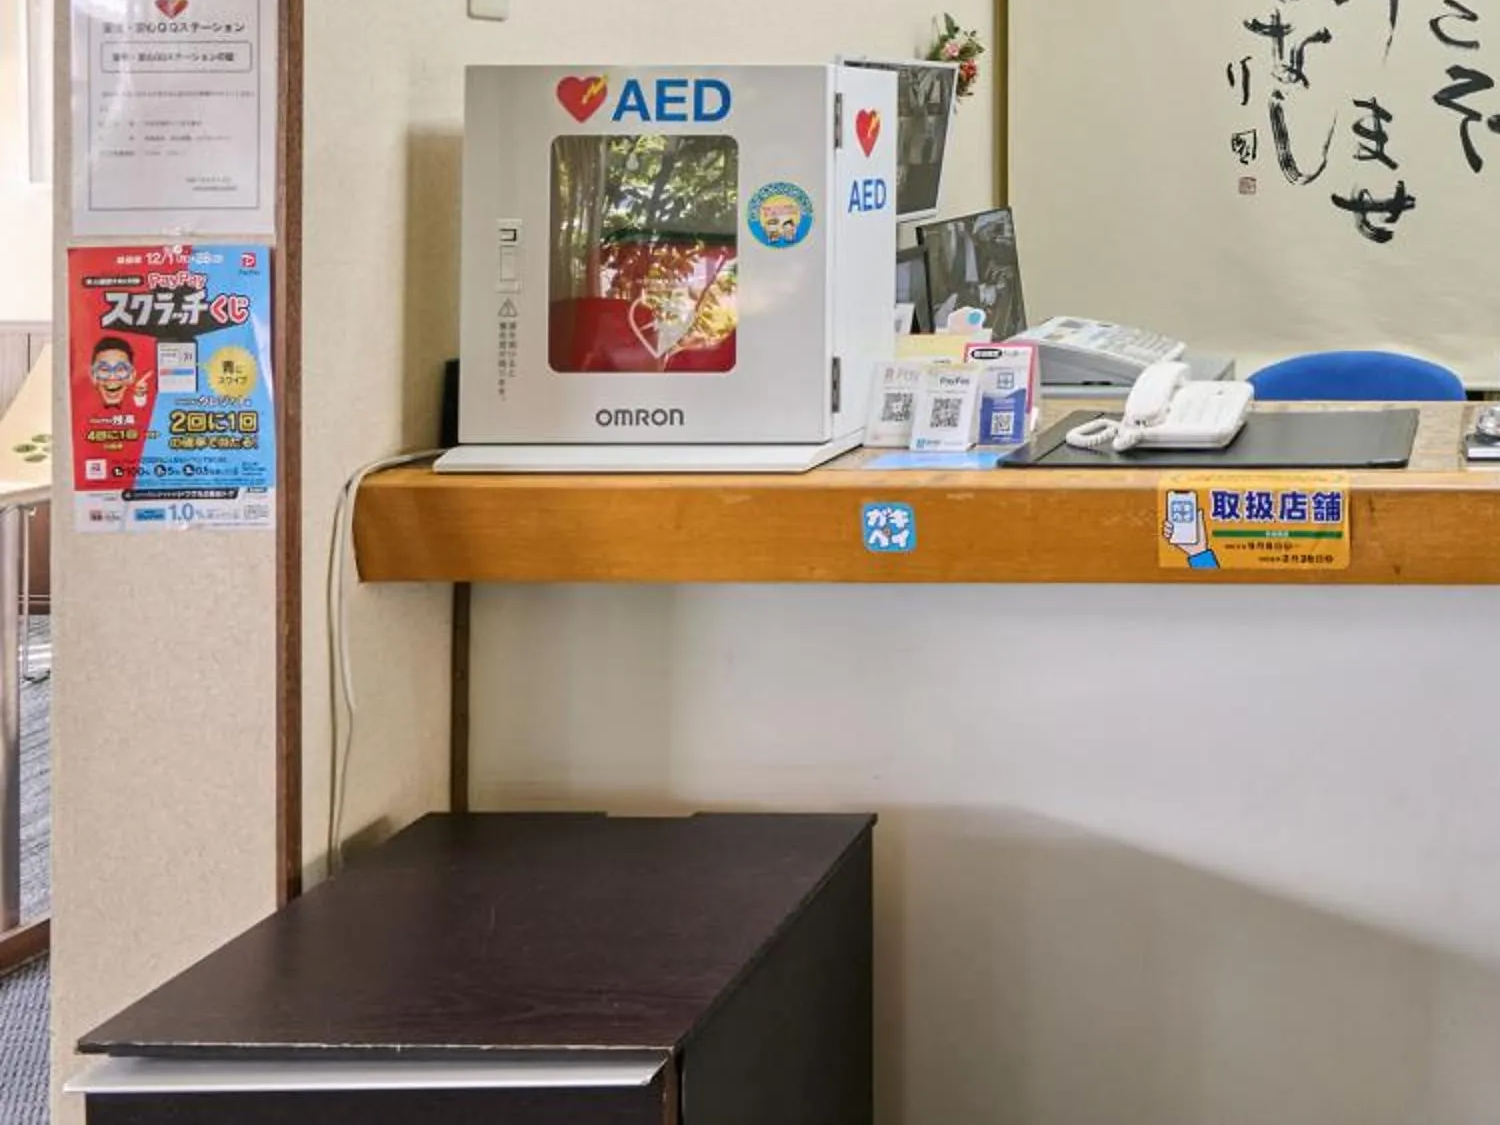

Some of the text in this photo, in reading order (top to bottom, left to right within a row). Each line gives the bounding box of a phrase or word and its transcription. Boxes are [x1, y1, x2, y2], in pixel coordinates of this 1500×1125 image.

[612, 78, 732, 123] AED
[848, 178, 887, 213] AED
[103, 291, 249, 326] スクラッチくじ
[170, 410, 258, 433] 2回に1回
[866, 507, 909, 528] ガキ
[1211, 490, 1342, 522] 取扱店舗
[868, 528, 909, 547] ペイ
